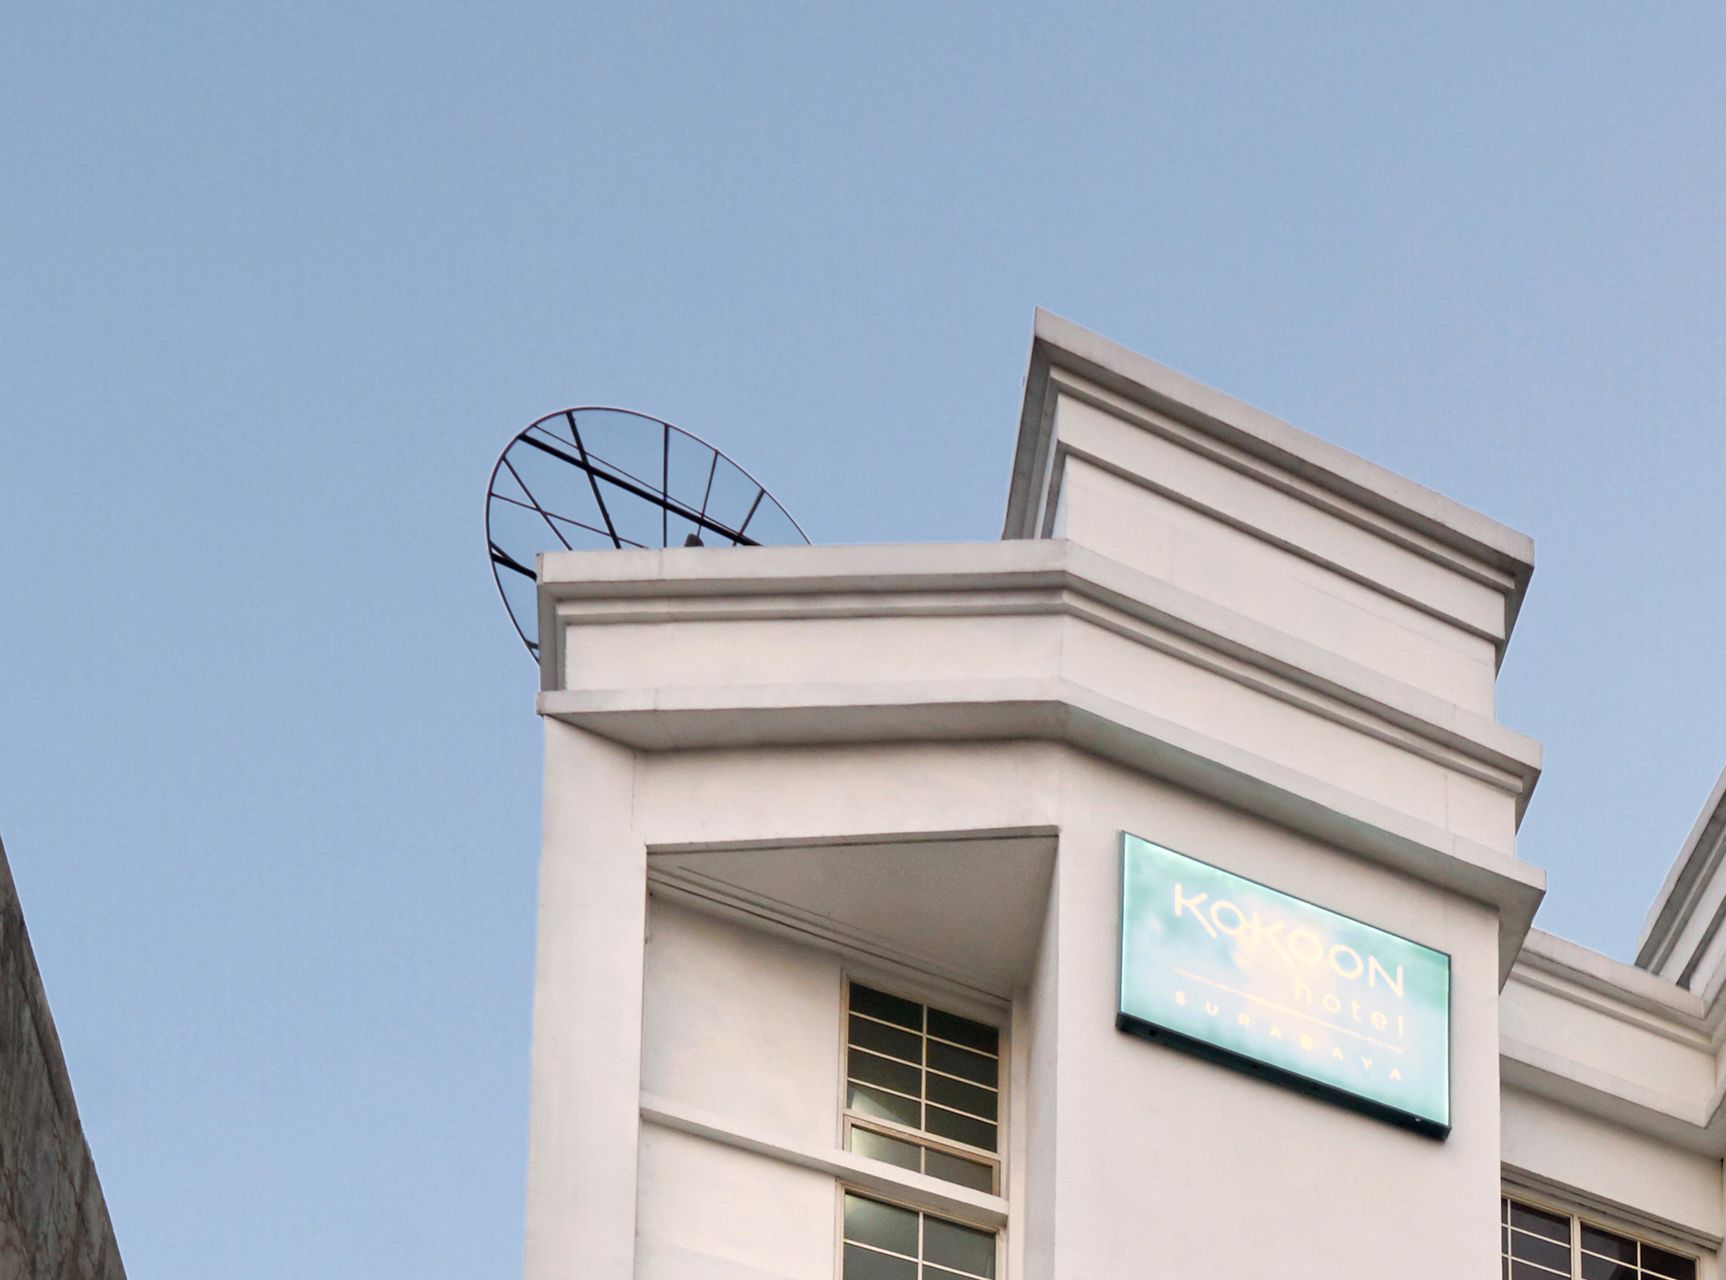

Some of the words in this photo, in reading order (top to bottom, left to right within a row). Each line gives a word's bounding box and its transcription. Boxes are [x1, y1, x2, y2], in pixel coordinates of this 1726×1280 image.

[1174, 883, 1404, 999] KOKOON
[1175, 991, 1402, 1081] SURABAYA
[1295, 978, 1404, 1036] hotel
